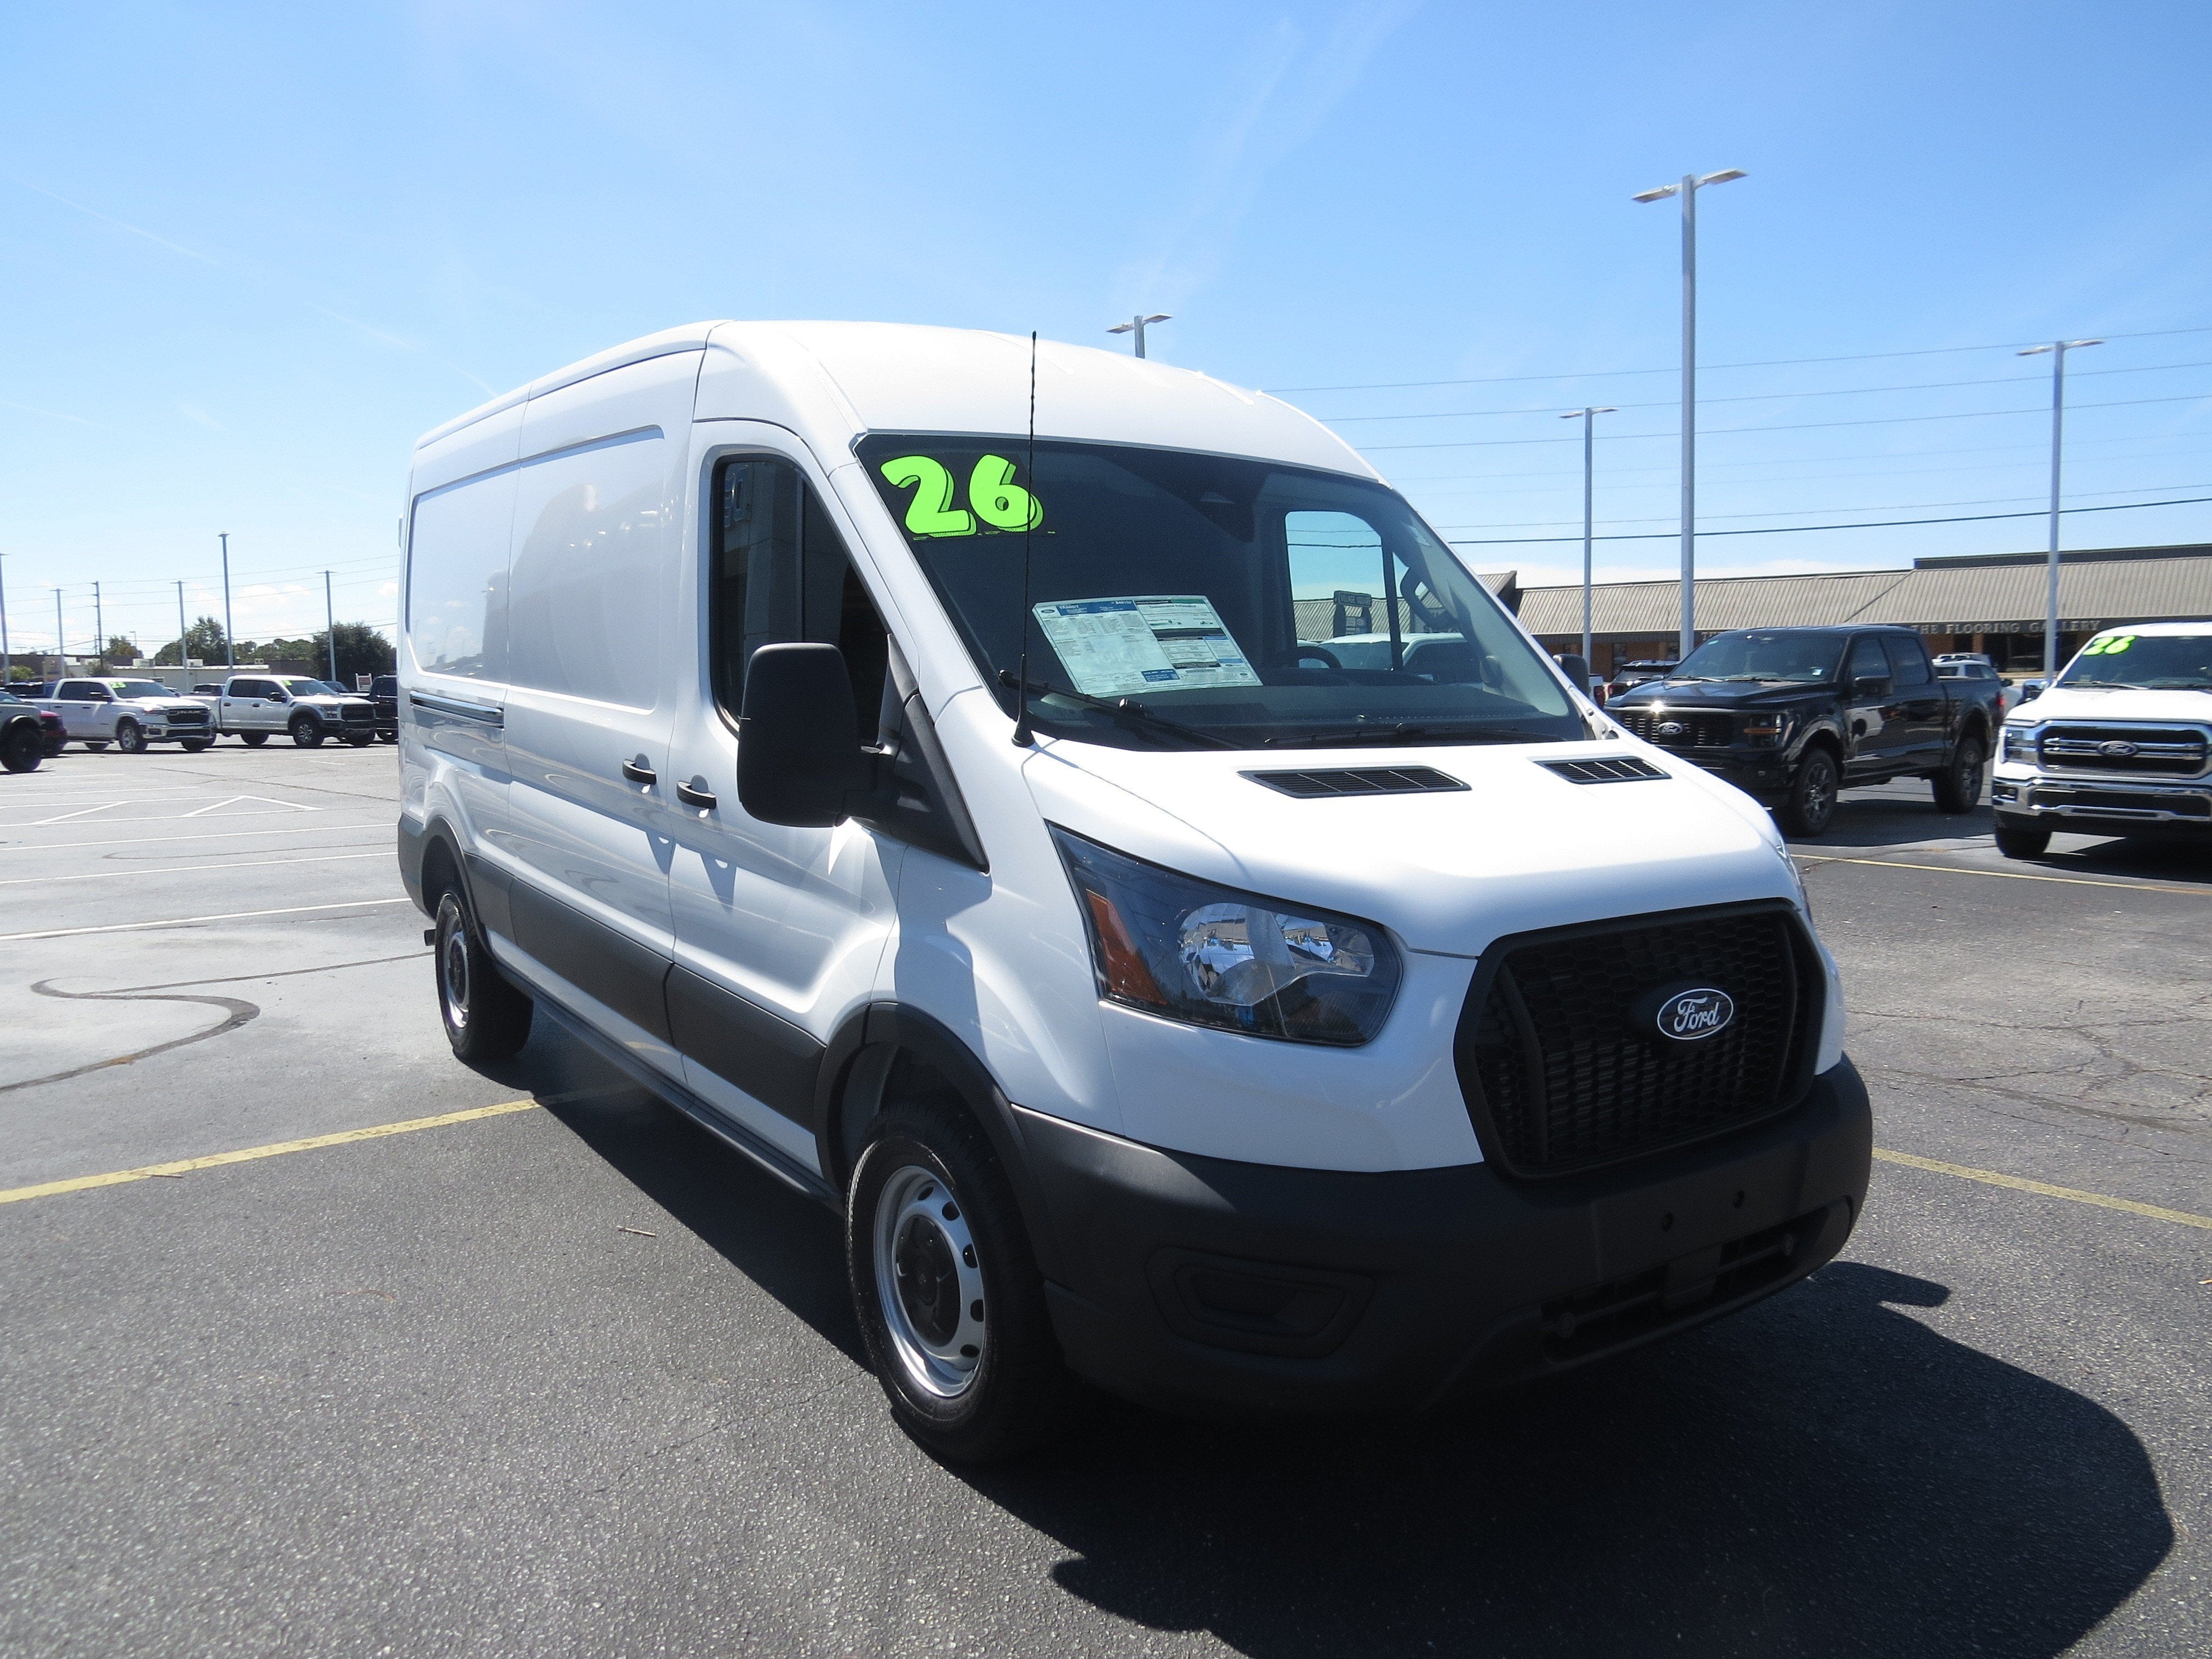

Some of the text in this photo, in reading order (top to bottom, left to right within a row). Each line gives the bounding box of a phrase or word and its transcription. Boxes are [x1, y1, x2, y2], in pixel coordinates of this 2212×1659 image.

[880, 453, 1044, 537] 26
[1911, 620, 2100, 634] THE FLOORING GLERY
[2083, 635, 2136, 656] 26
[1674, 997, 1720, 1032] Ford
